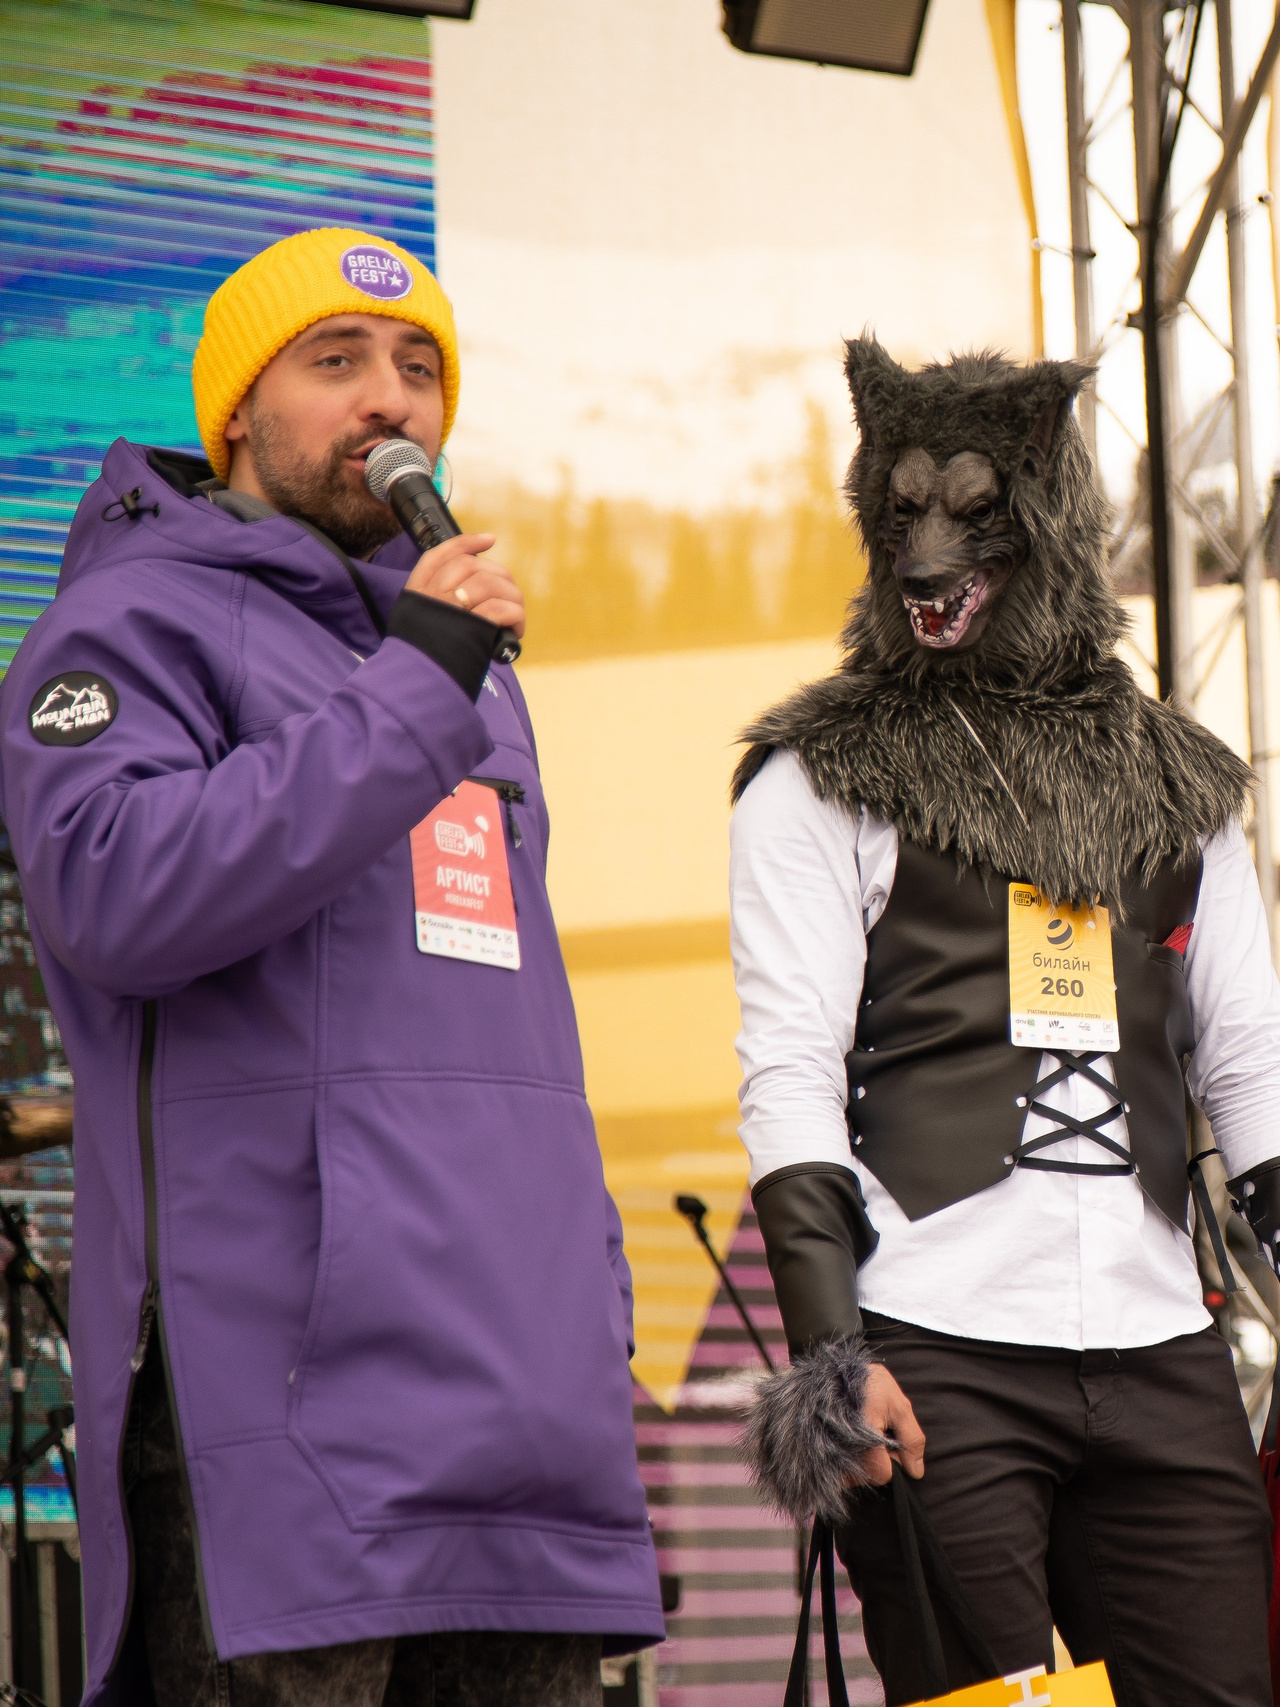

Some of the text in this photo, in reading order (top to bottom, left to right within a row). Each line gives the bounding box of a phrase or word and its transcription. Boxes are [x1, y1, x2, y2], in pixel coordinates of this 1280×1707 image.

[347, 254, 402, 274] GRELKA
[350, 268, 388, 285] FEST
[31, 699, 109, 729] MOUNTAIN
[74, 708, 112, 729] MAN
[435, 865, 490, 898] АРТИСТ
[1032, 952, 1091, 972] билайн
[1041, 977, 1084, 998] 260
